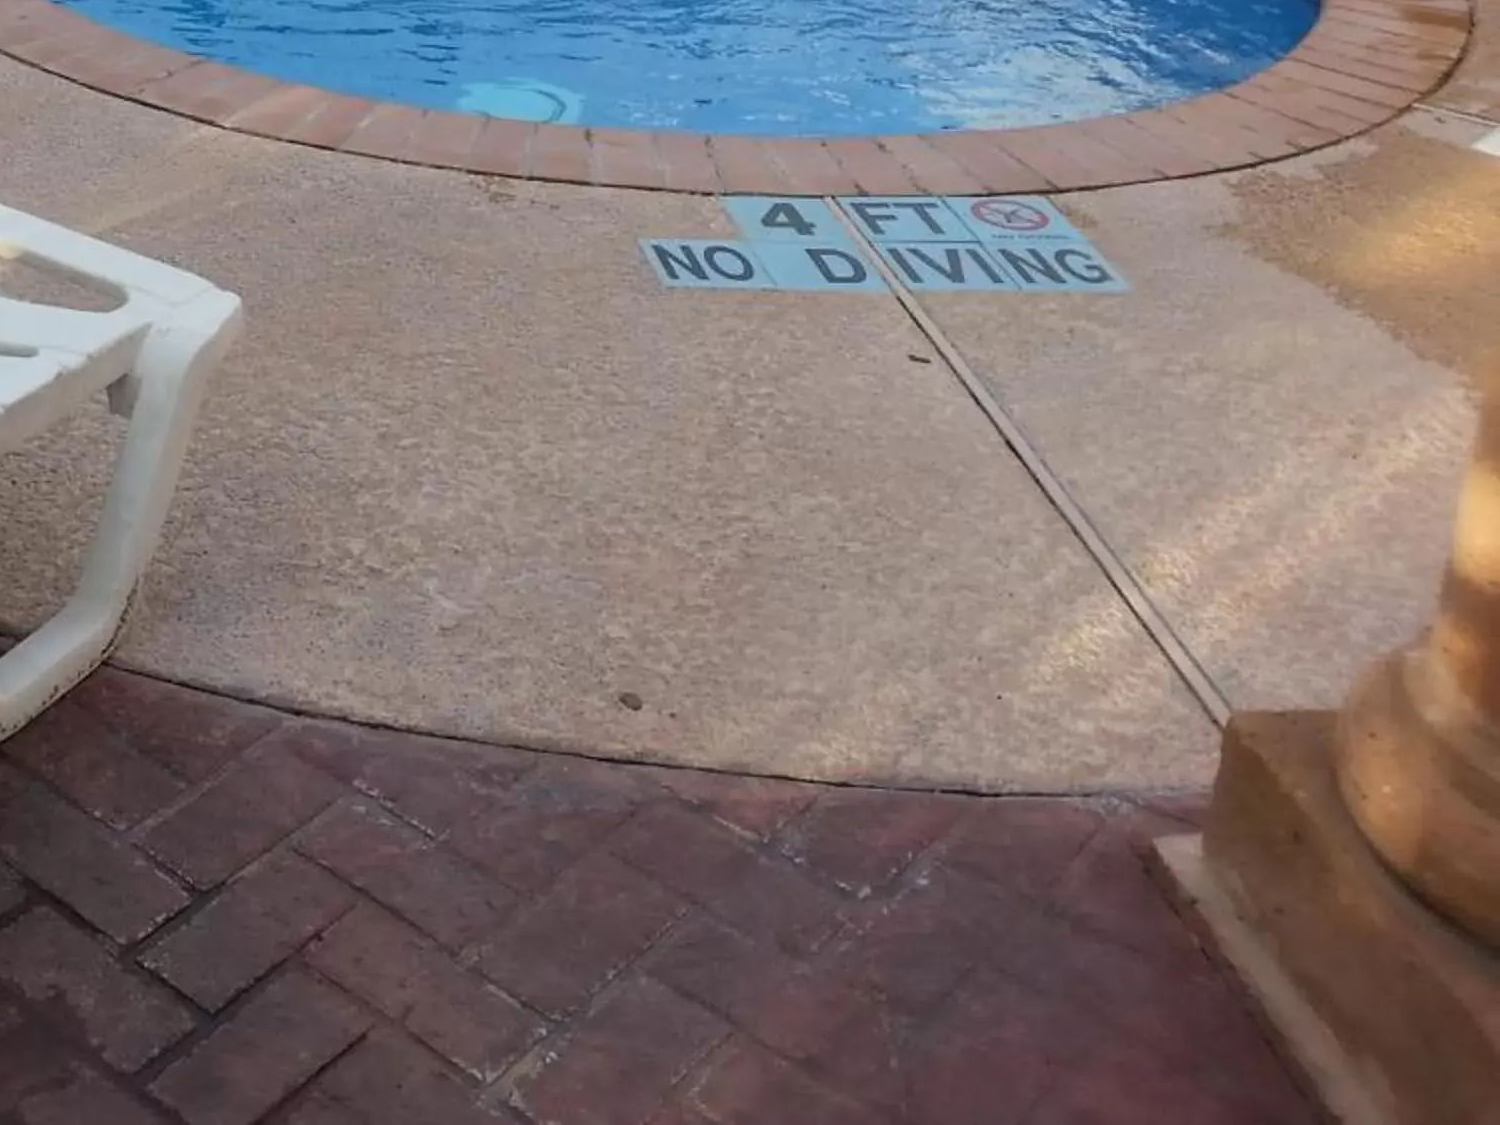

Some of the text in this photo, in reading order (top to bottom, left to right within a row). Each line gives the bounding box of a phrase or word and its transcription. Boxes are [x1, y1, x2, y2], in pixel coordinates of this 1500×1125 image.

[760, 202, 946, 236] 4 FT
[651, 244, 1114, 284] NO DIVING
